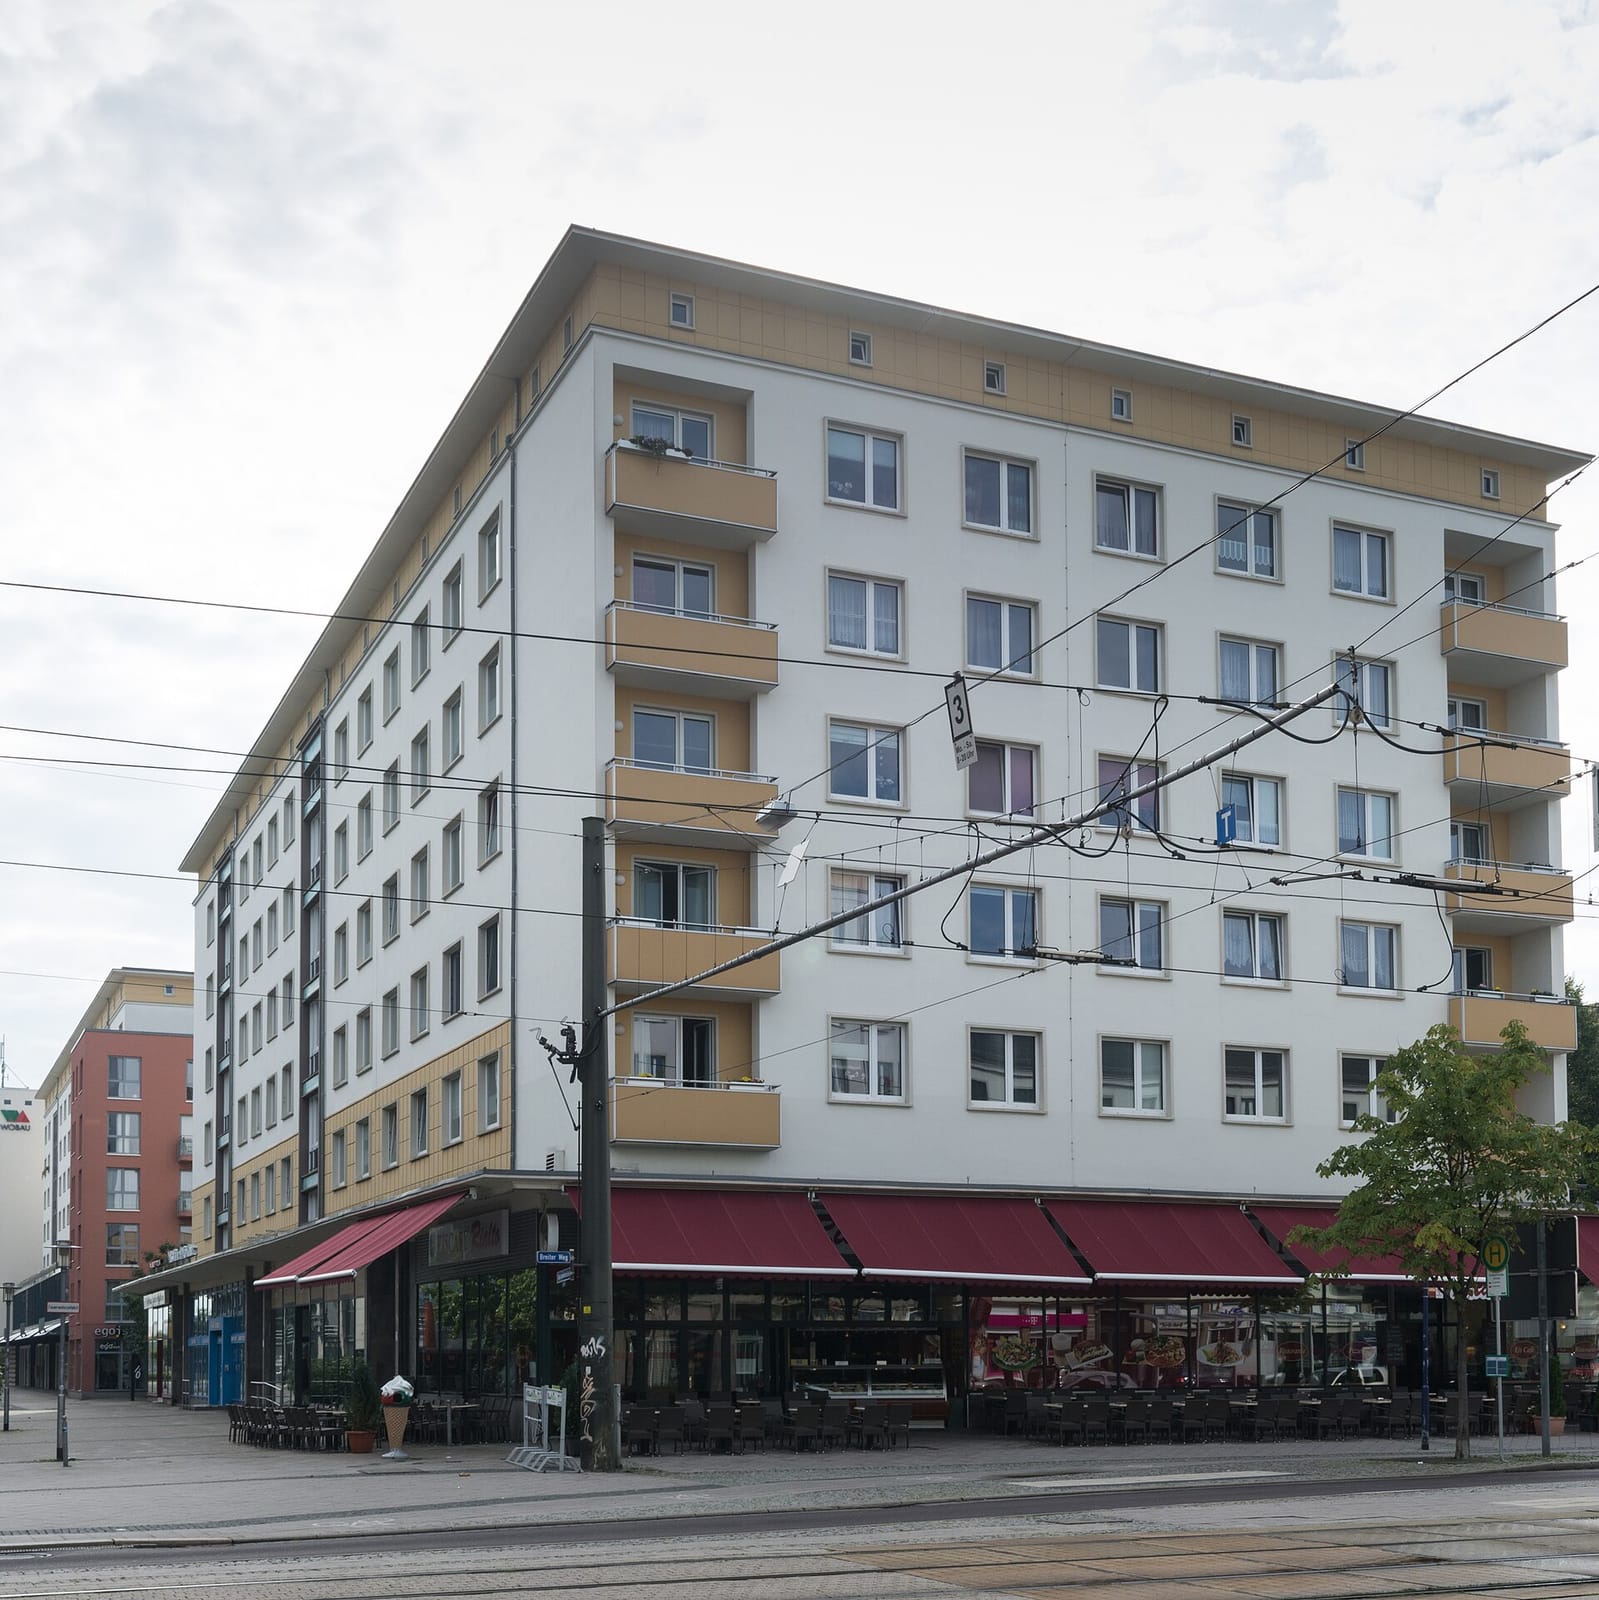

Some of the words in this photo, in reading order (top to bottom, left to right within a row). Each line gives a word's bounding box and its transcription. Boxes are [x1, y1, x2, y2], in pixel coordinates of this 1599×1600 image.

[952, 694, 965, 725] 3
[1221, 810, 1232, 838] T
[0, 1123, 31, 1132] WOBAU
[539, 1253, 557, 1261] Breiter
[557, 1253, 569, 1263] Weg
[1489, 1246, 1501, 1264] H
